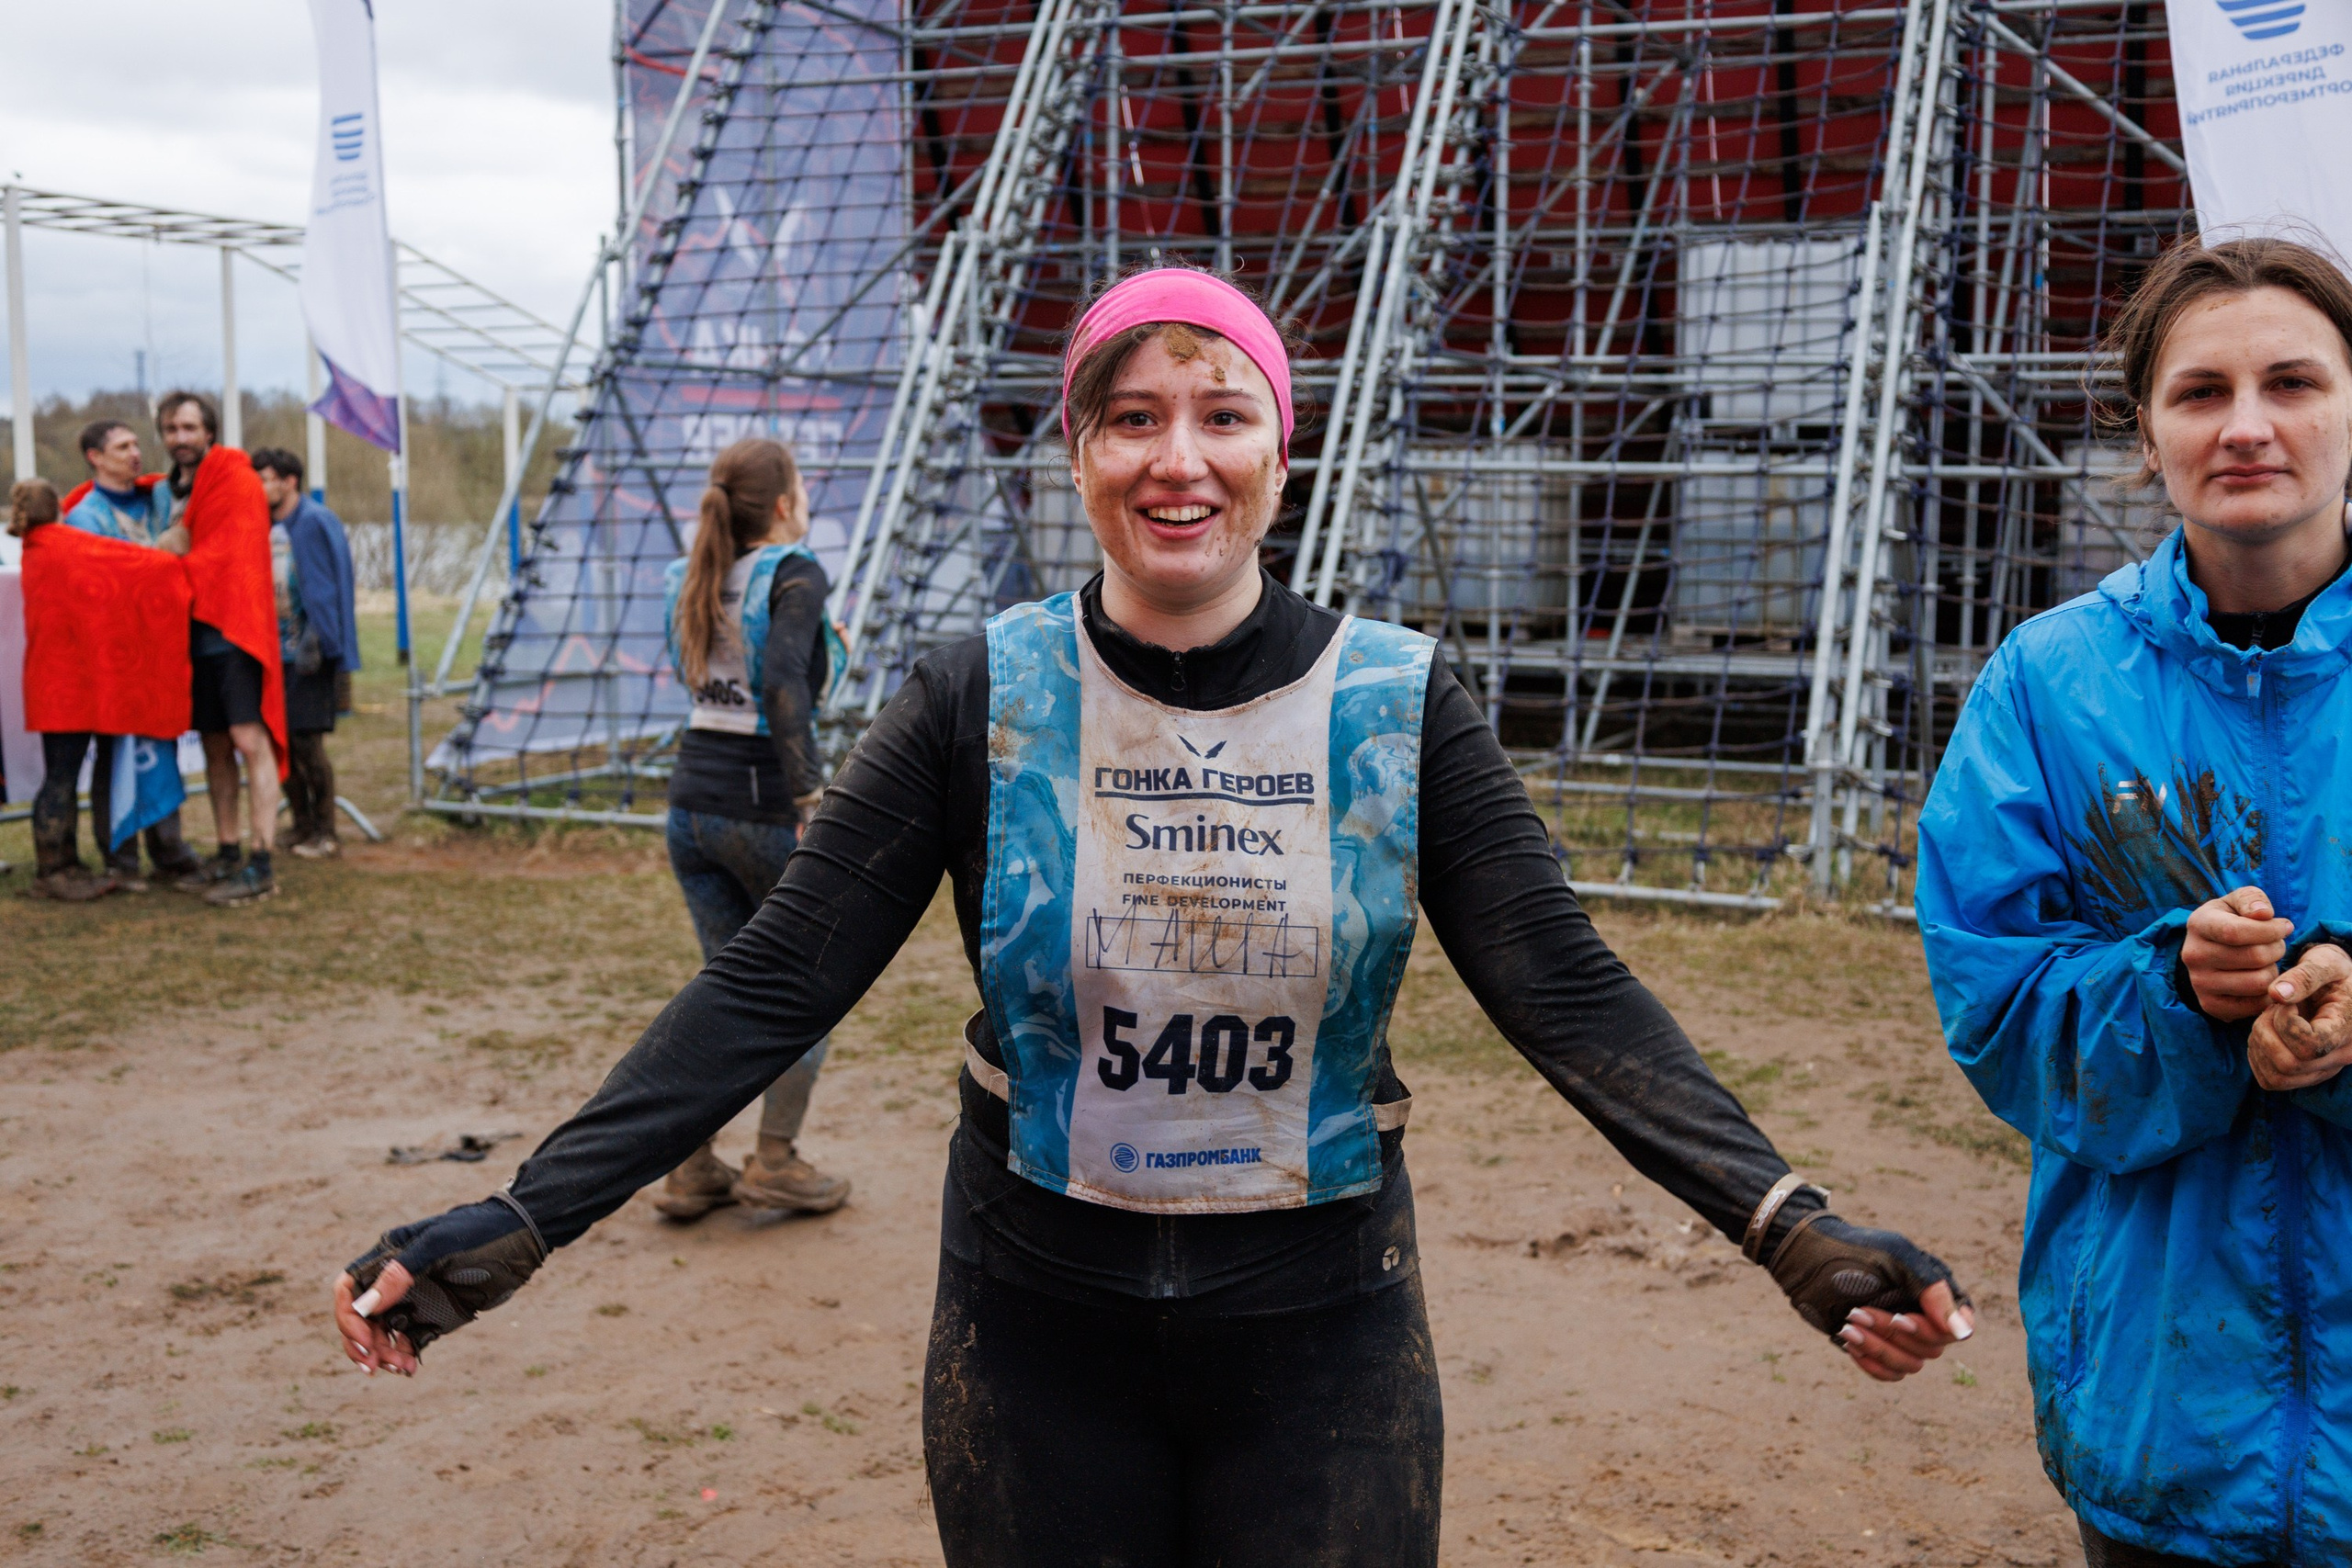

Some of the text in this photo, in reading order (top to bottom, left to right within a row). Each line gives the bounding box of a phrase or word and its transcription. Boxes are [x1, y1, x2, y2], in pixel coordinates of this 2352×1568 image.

[1095, 767, 1315, 796] ГОНКА ГЕРОЕВ
[1125, 814, 1284, 855] Sminex
[1124, 873, 1286, 891] ПЕРФЕКЦИОНИСТЫ
[1122, 894, 1287, 912] FINE DEVELOPMENT
[1098, 1006, 1295, 1095] 5403
[1146, 1147, 1262, 1168] ГАЗПРОМБАНК
